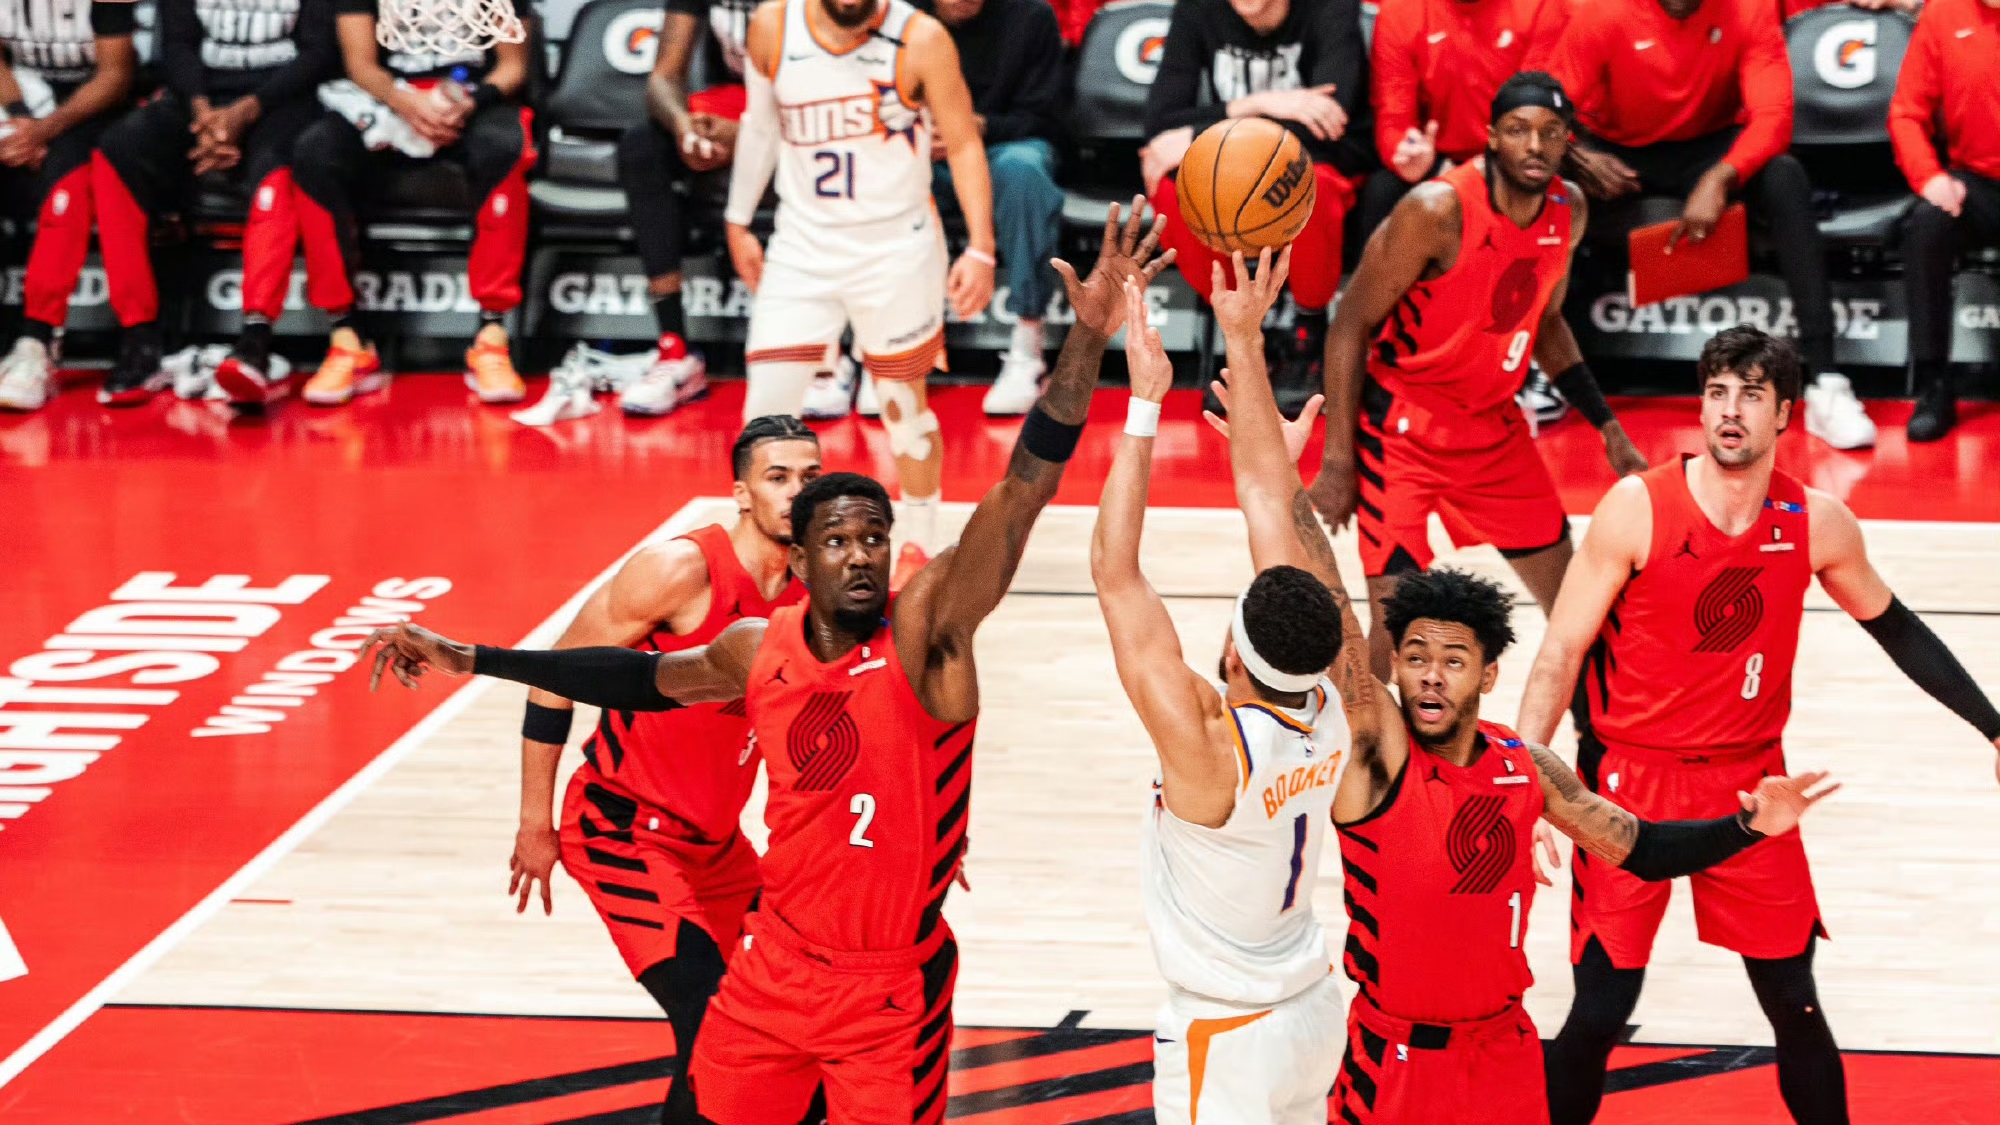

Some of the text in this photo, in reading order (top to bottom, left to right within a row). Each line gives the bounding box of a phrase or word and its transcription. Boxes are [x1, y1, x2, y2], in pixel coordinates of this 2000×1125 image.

[1814, 20, 1877, 89] G
[814, 151, 856, 199] 21
[1502, 330, 1530, 372] 9
[190, 576, 452, 738] WINDOWS
[1740, 652, 1764, 701] 8
[849, 792, 876, 848] 2
[1279, 812, 1309, 915] 1
[1508, 890, 1522, 949] 1
